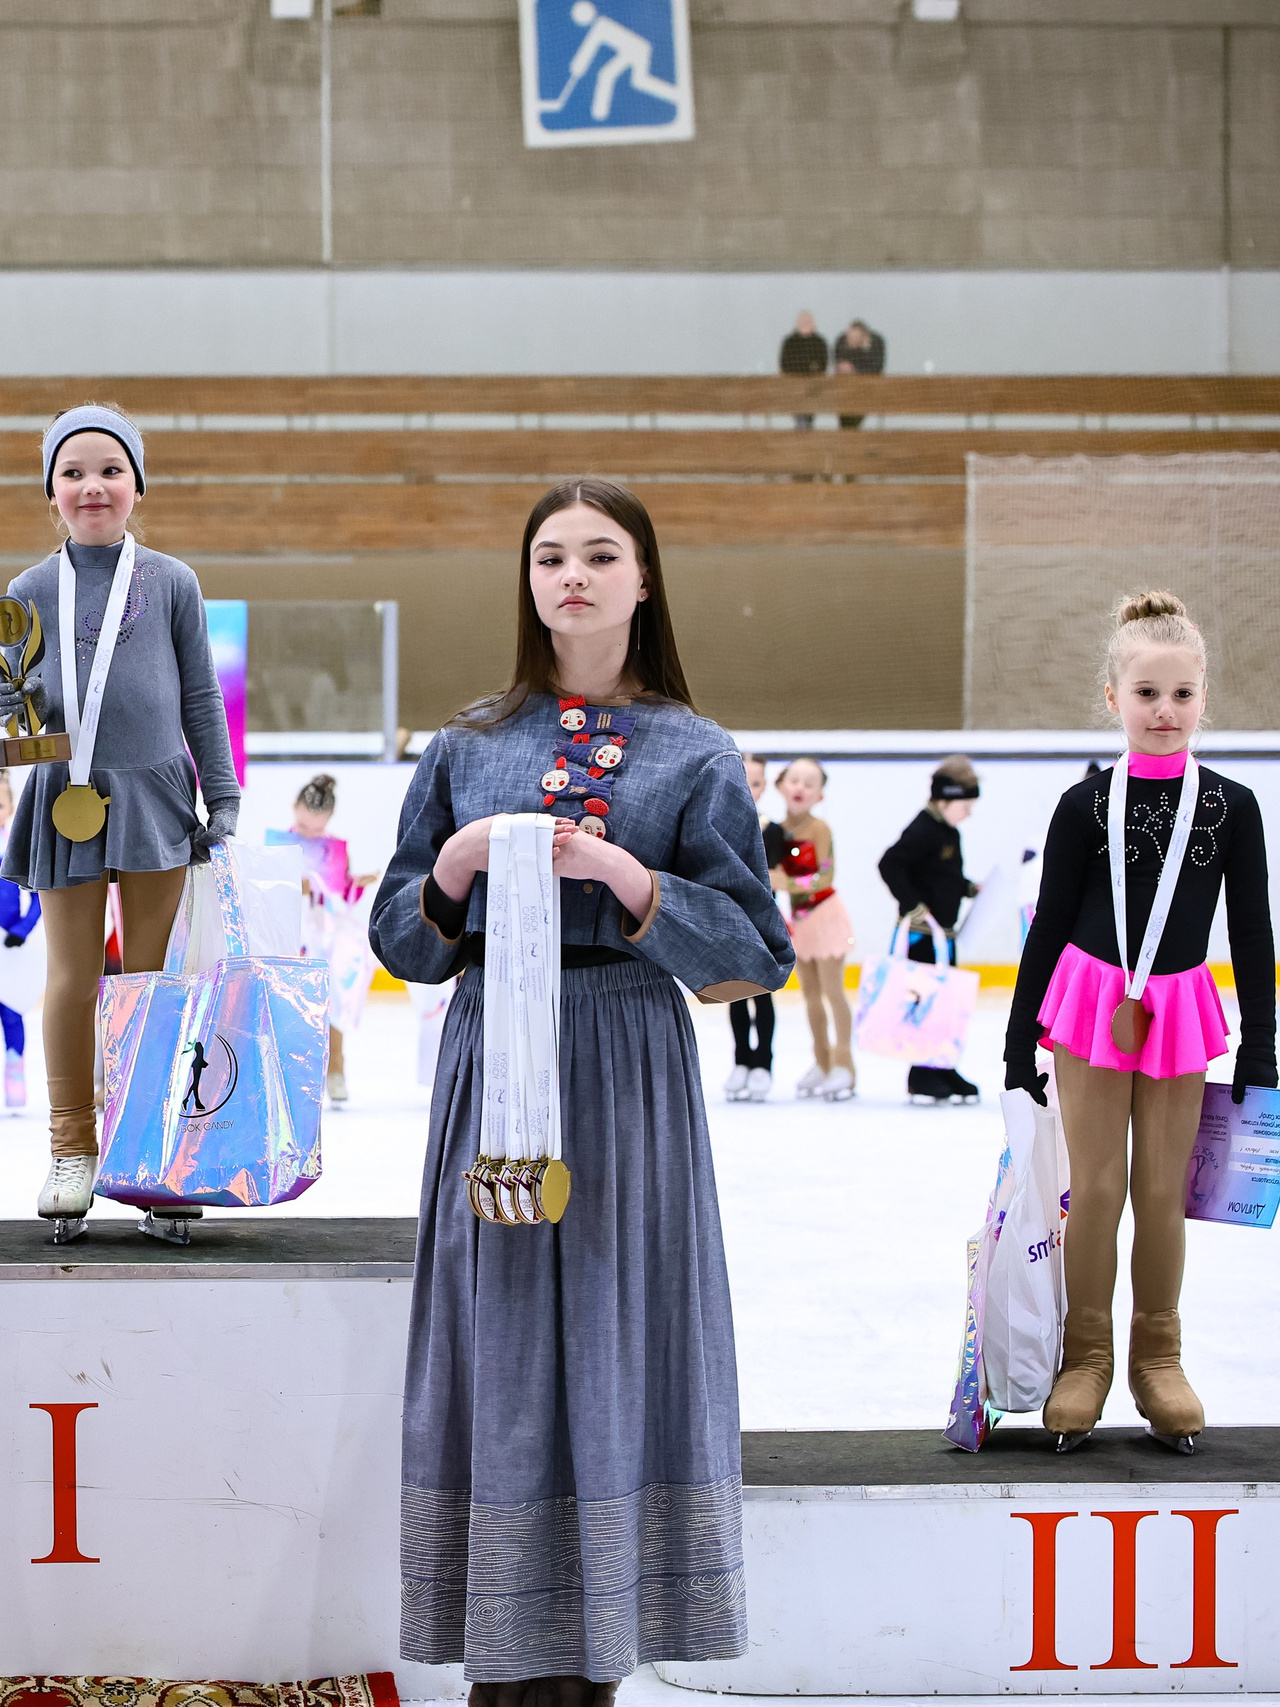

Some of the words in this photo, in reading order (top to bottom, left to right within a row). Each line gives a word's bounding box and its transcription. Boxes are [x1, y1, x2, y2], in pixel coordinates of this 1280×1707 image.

[522, 906, 530, 934] CANDY
[529, 905, 539, 933] КУБОК
[536, 1070, 544, 1098] CANDY
[204, 1120, 234, 1131] CANDY
[1202, 1148, 1219, 1170] КУБОК
[28, 1402, 101, 1564] I
[1009, 1509, 1239, 1672] III
